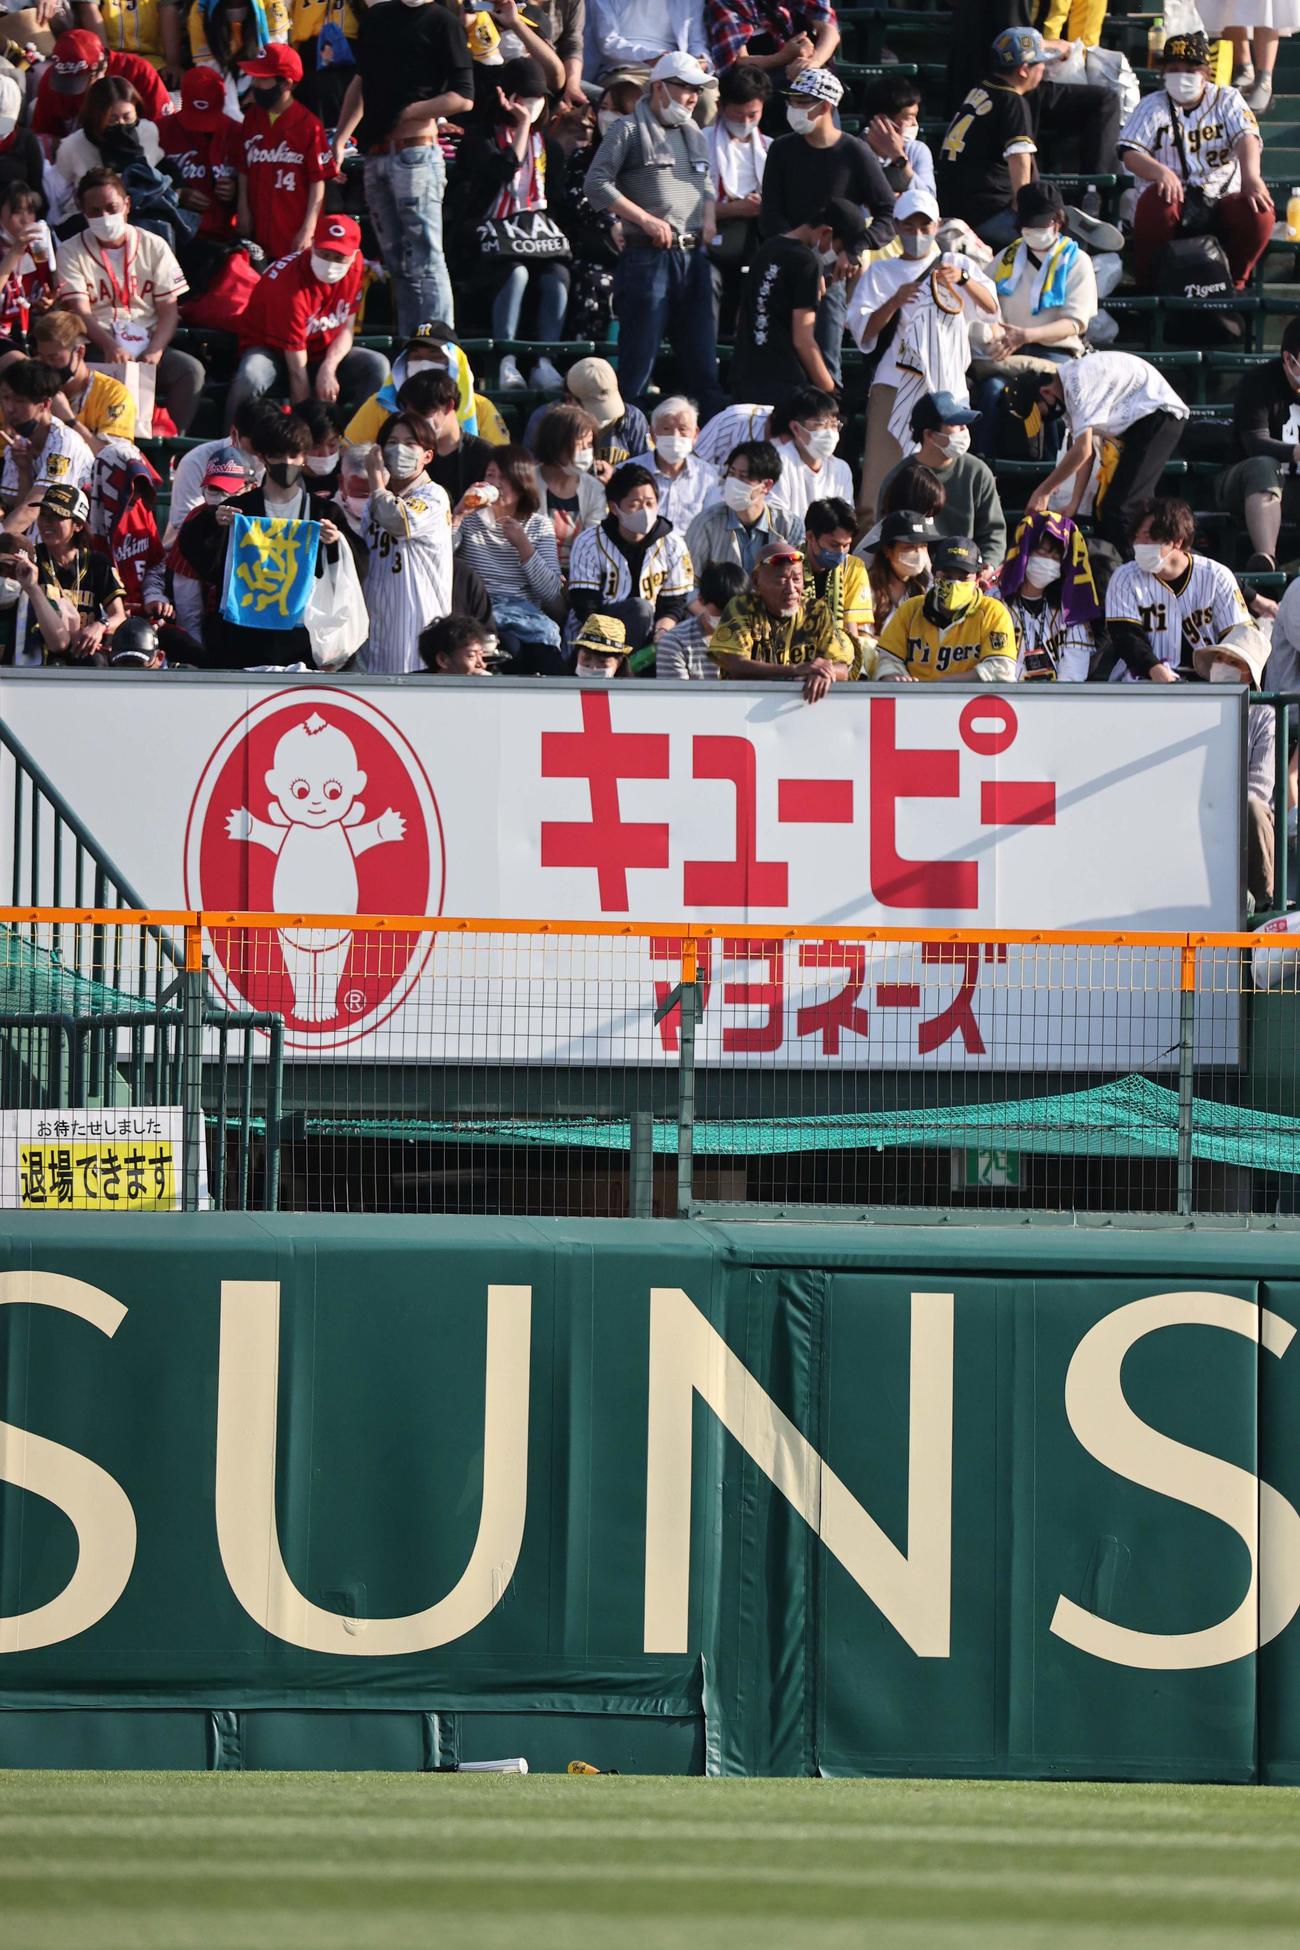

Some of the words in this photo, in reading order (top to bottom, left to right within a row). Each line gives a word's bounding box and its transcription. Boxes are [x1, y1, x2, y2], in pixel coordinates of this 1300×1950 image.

[1151, 124, 1223, 153] Tiger
[243, 134, 304, 168] Hiroshima
[274, 168, 297, 192] 14
[512, 238, 561, 253] COFFEE
[1183, 281, 1227, 298] Tigers
[134, 560, 146, 581] 5
[391, 551, 403, 574] 3
[907, 637, 982, 672] Tigers
[541, 690, 1056, 912] キューピー
[37, 1118, 162, 1138] お待たせしました
[21, 1146, 173, 1203] 退場できます
